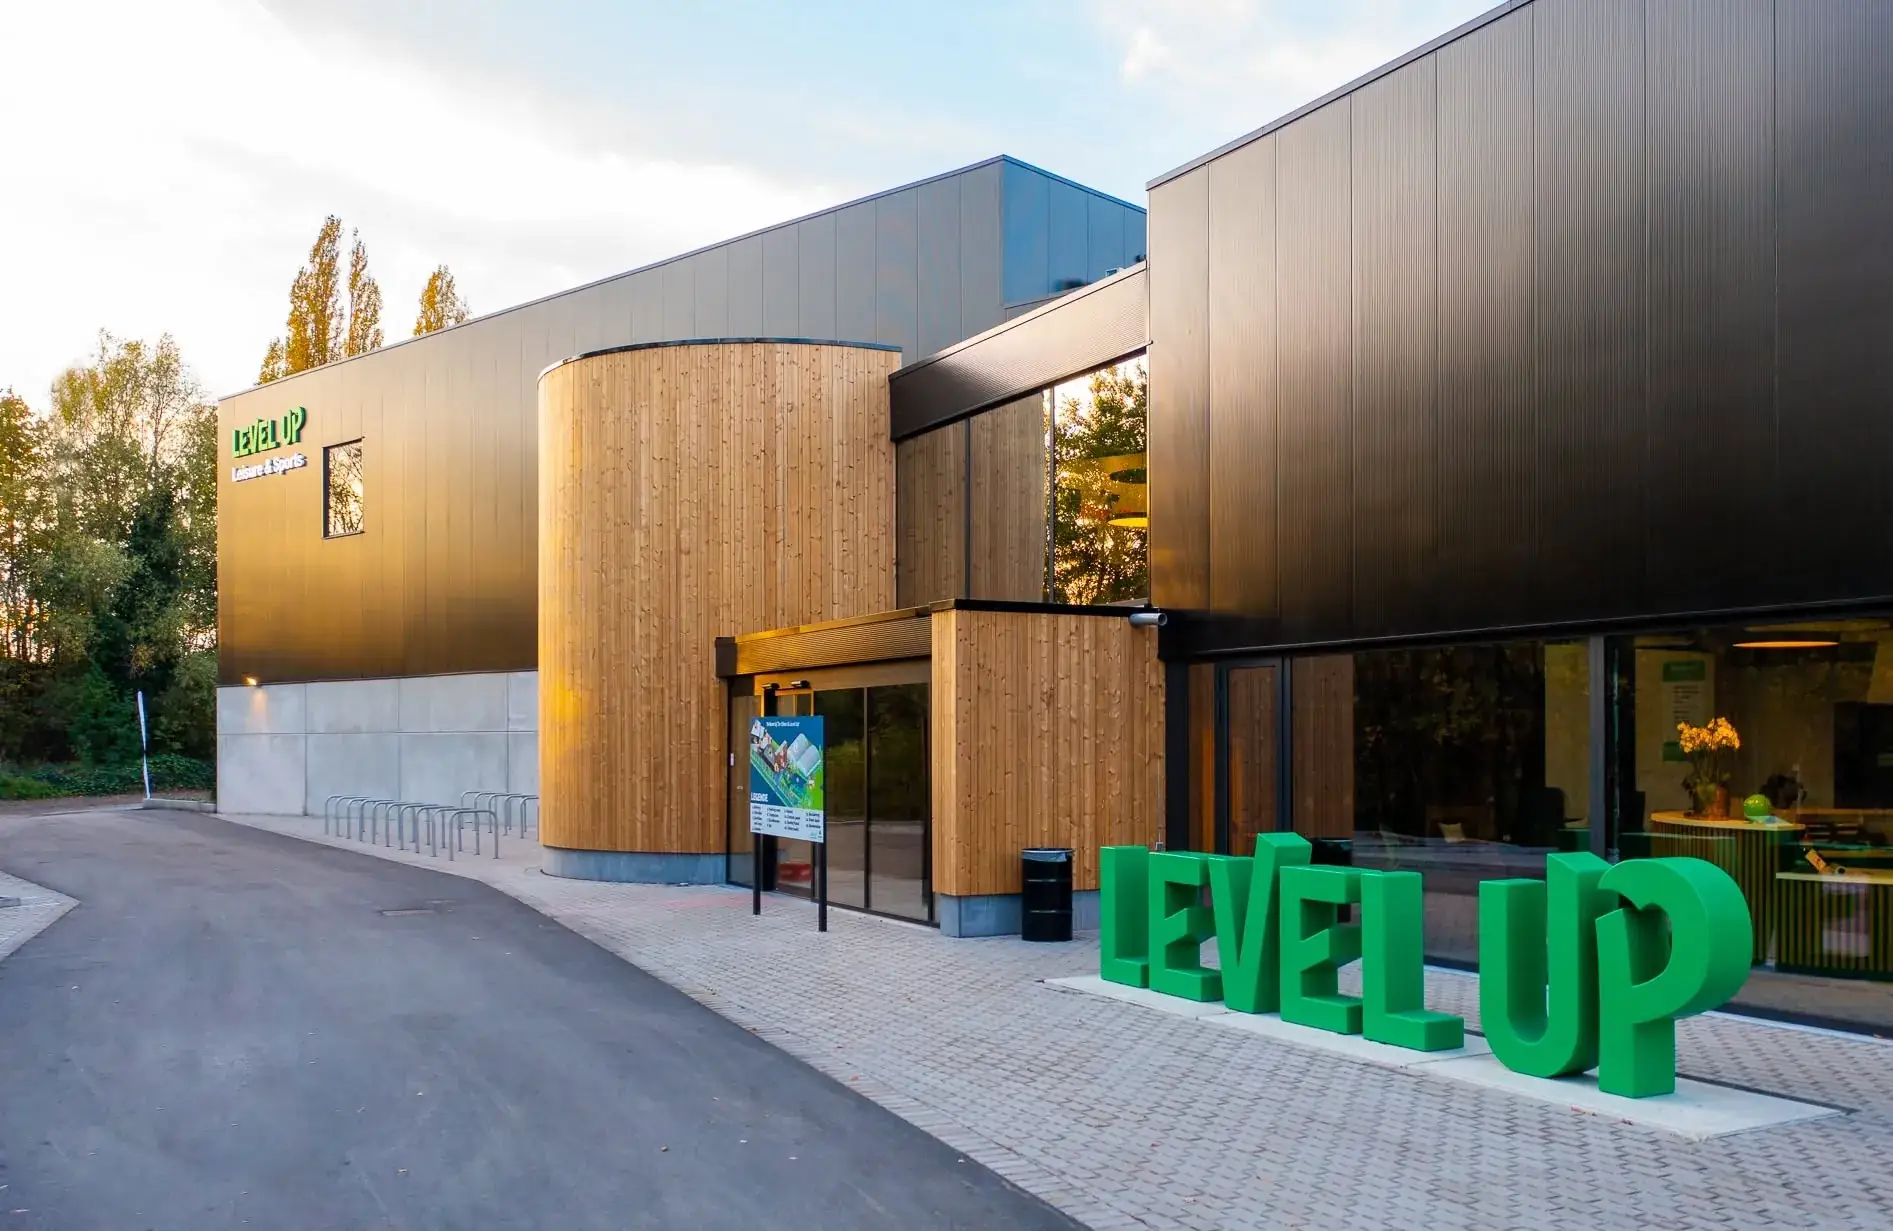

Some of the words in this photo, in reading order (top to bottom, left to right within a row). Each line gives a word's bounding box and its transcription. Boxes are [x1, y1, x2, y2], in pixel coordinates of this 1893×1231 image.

[232, 418, 279, 458] LEVEL
[281, 406, 306, 445] UP
[231, 464, 263, 482] Leisure
[264, 458, 274, 475] &
[274, 453, 306, 475] Sports
[1100, 832, 1464, 1052] LEVEL
[1479, 852, 1752, 1098] UP
